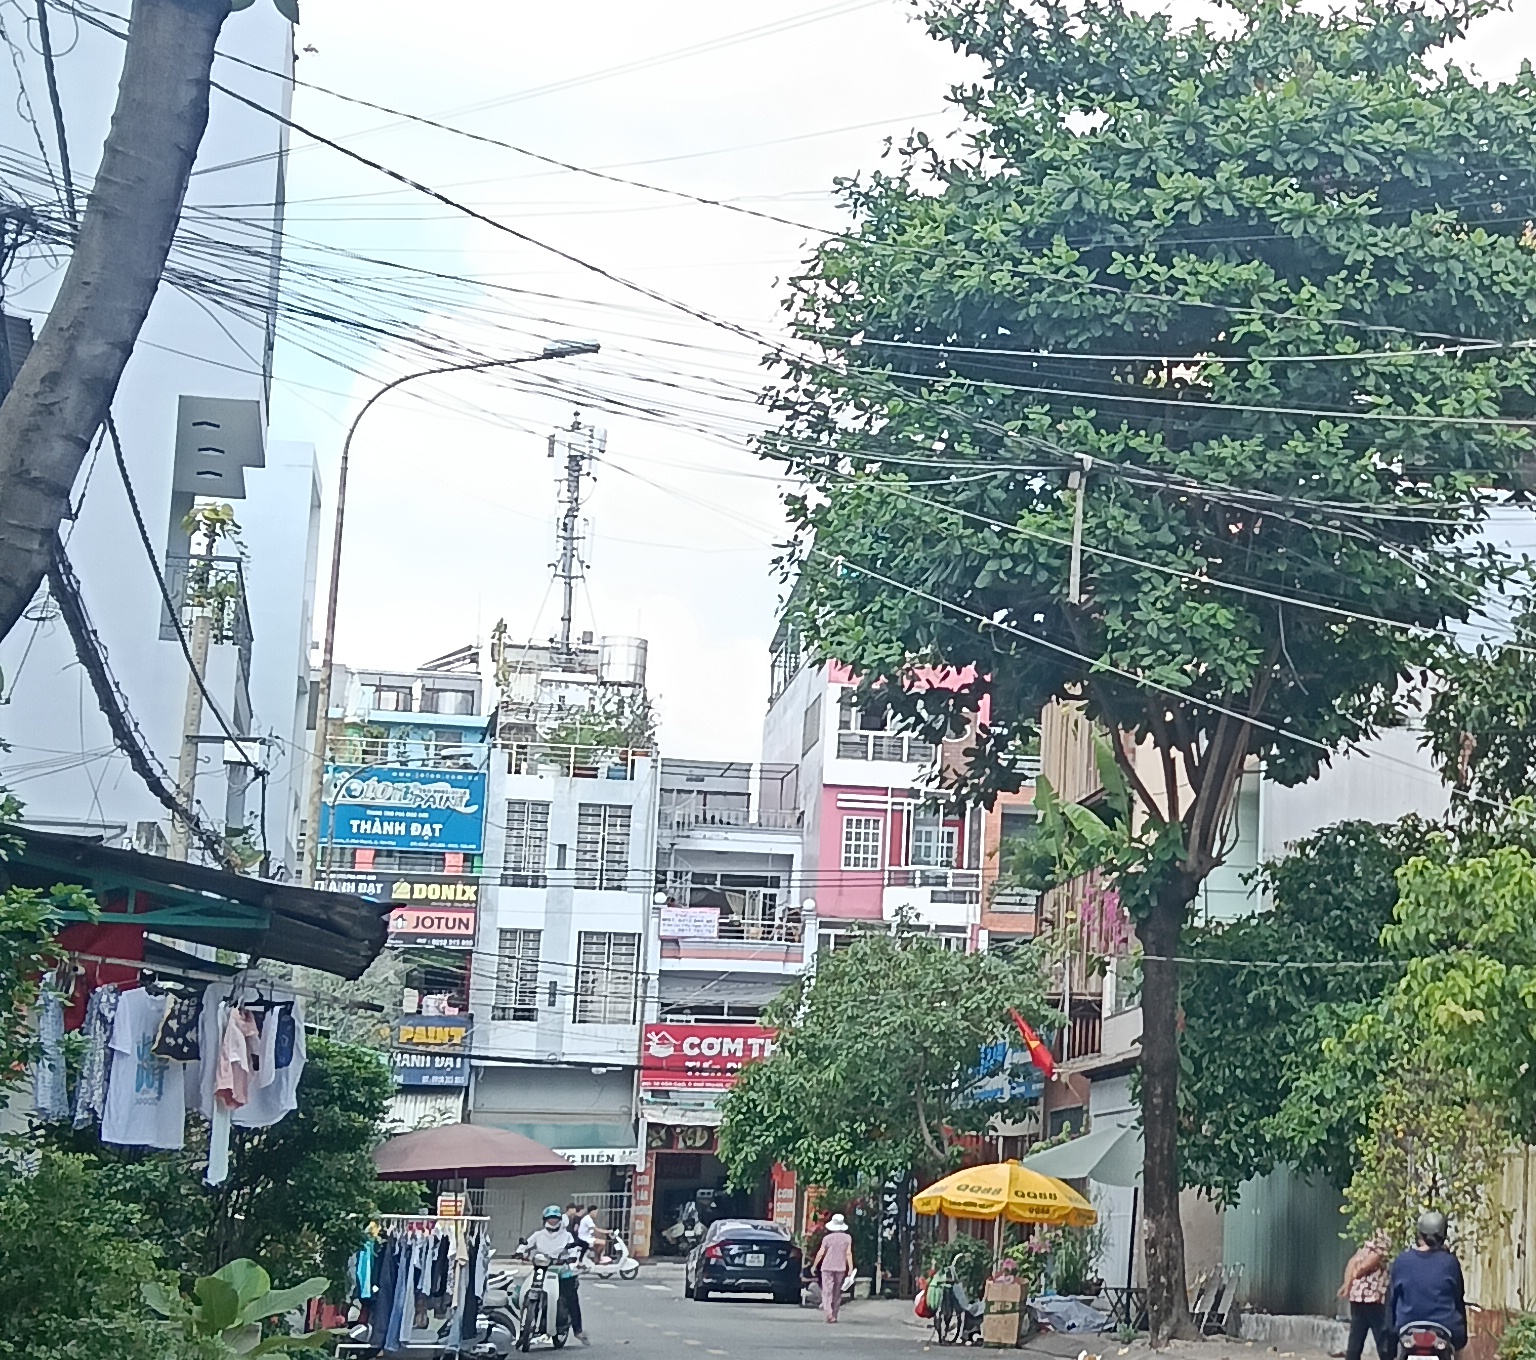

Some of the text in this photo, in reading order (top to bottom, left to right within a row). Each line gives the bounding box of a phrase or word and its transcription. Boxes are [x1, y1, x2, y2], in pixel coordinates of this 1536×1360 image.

[350, 817, 443, 840] THÀNH ĐẠT
[412, 915, 470, 931] JOTUN
[398, 1025, 466, 1044] PAINT
[682, 1036, 744, 1057] CƠM
